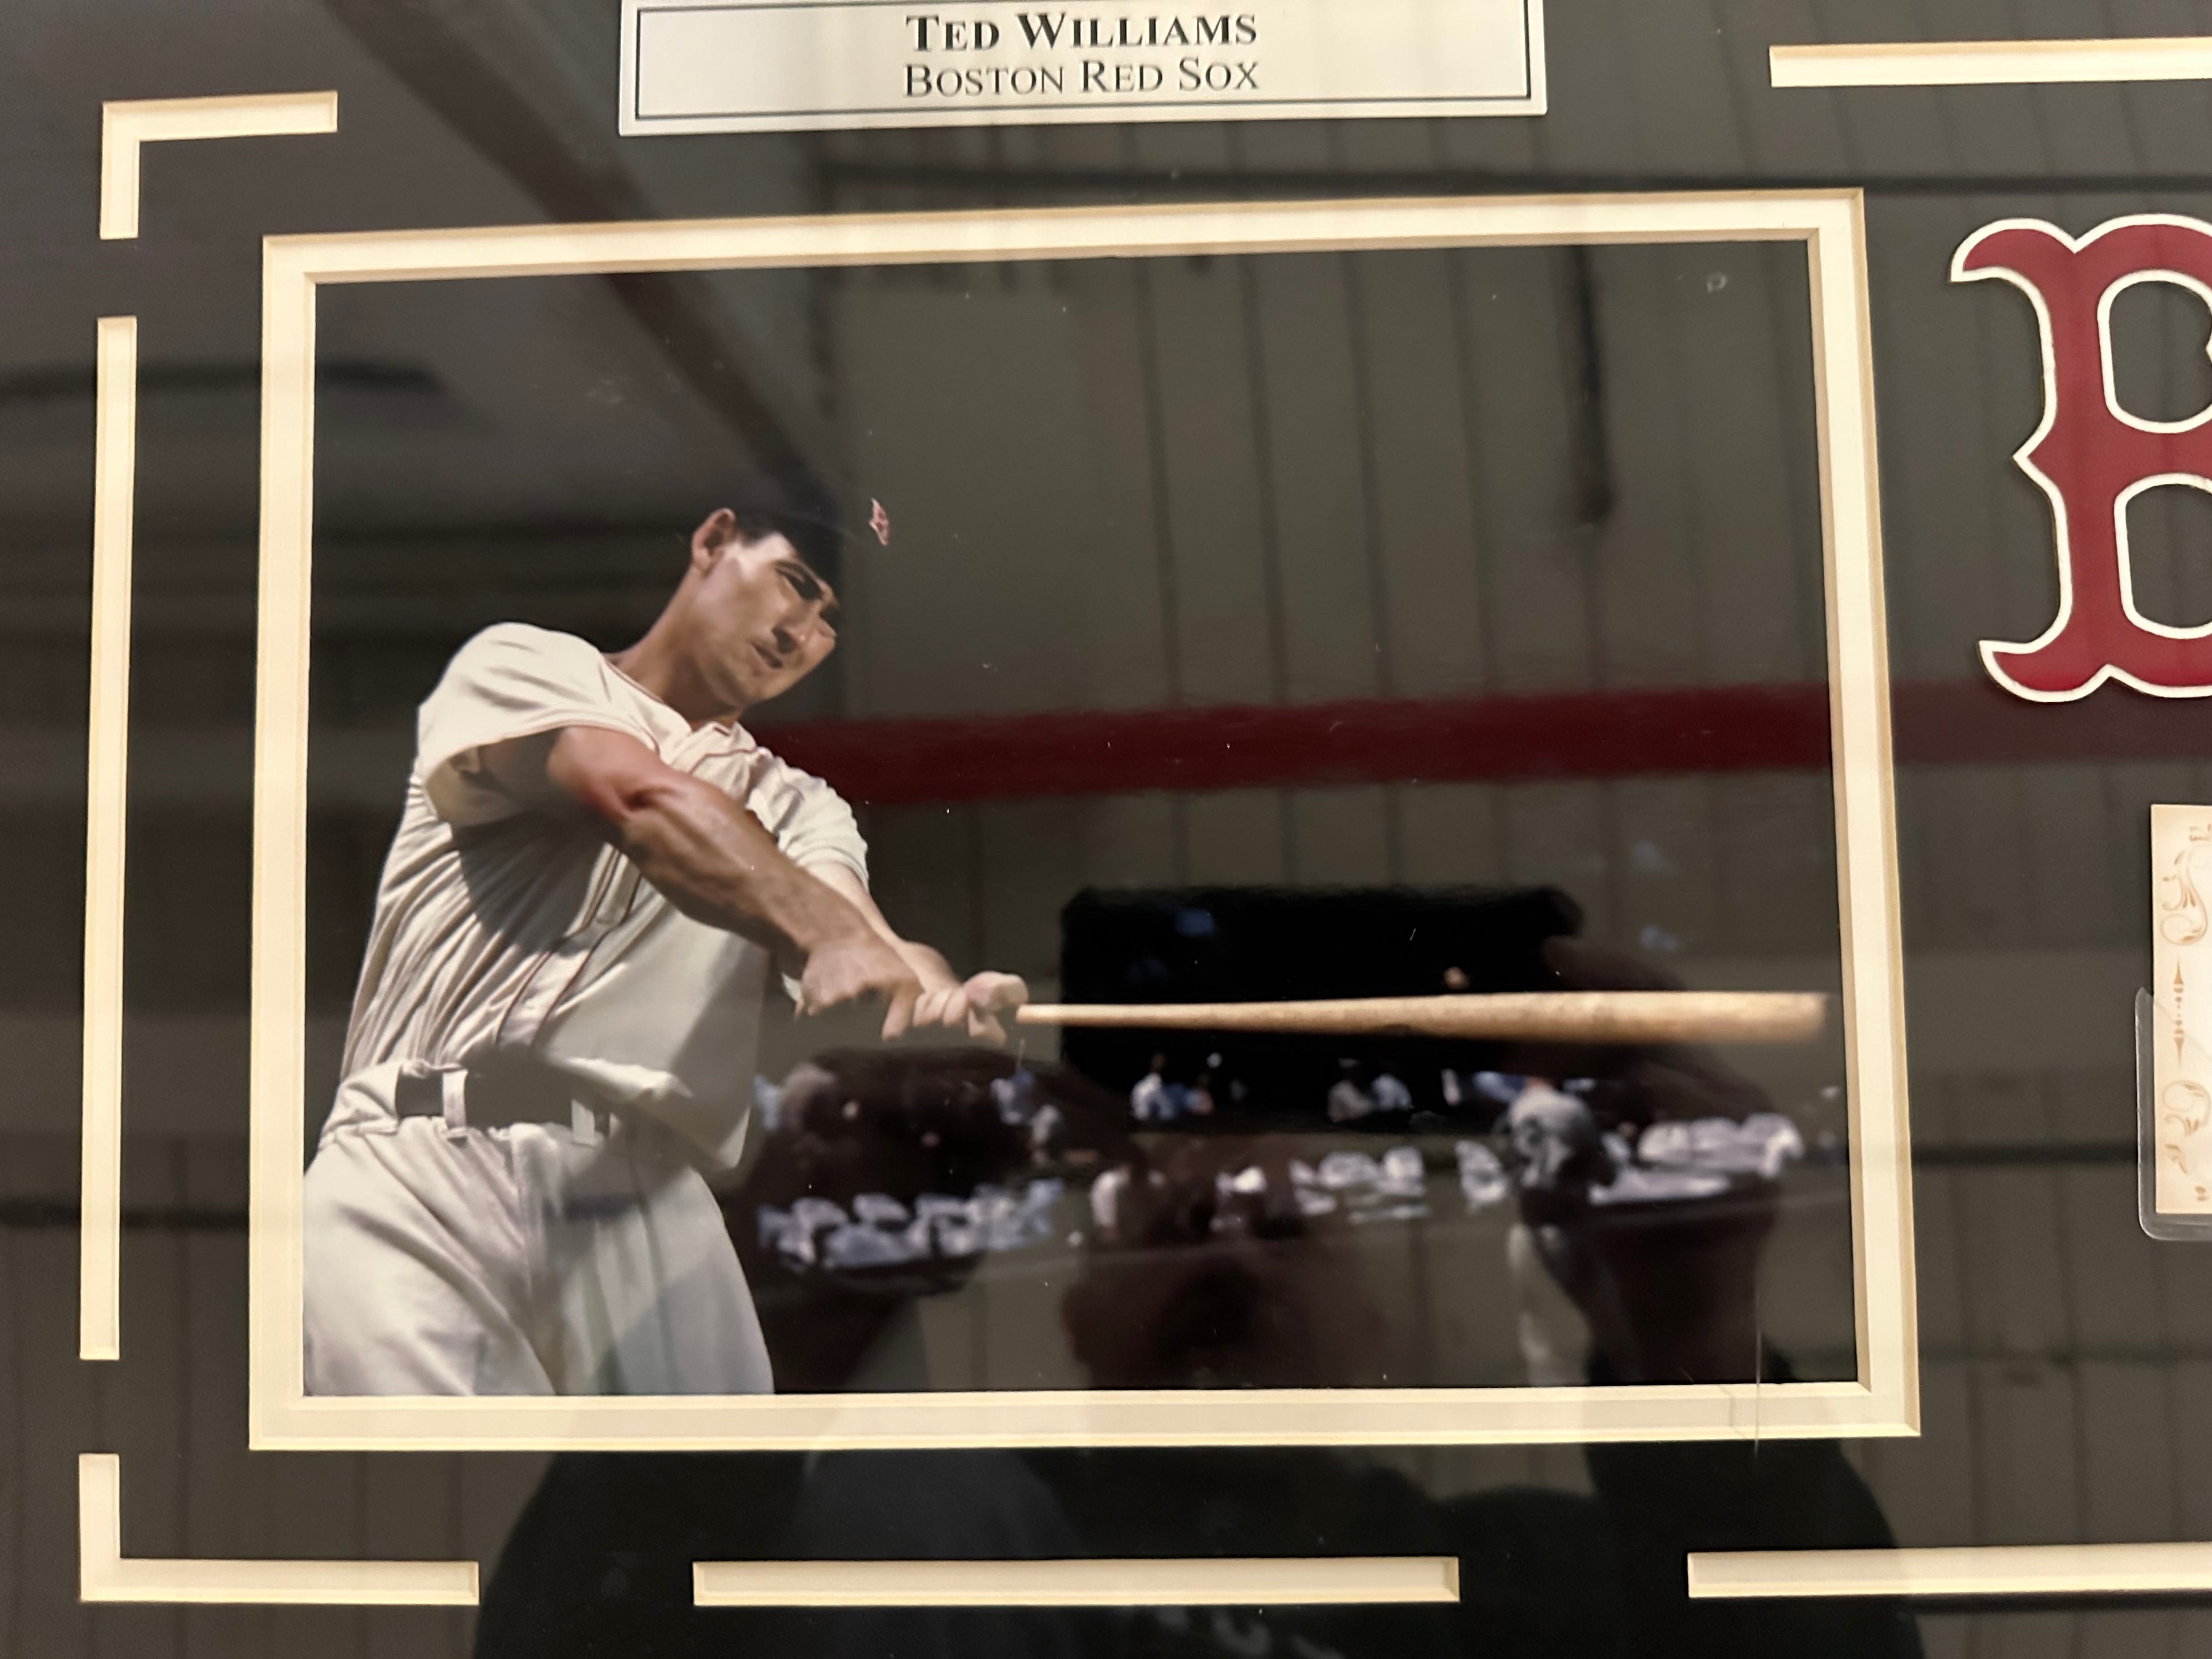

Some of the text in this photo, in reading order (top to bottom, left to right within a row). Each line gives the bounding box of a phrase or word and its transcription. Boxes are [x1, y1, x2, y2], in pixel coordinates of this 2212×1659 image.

[906, 12, 1257, 52] TED WILLIAMS
[904, 56, 1259, 97] BOSTON RED SOX
